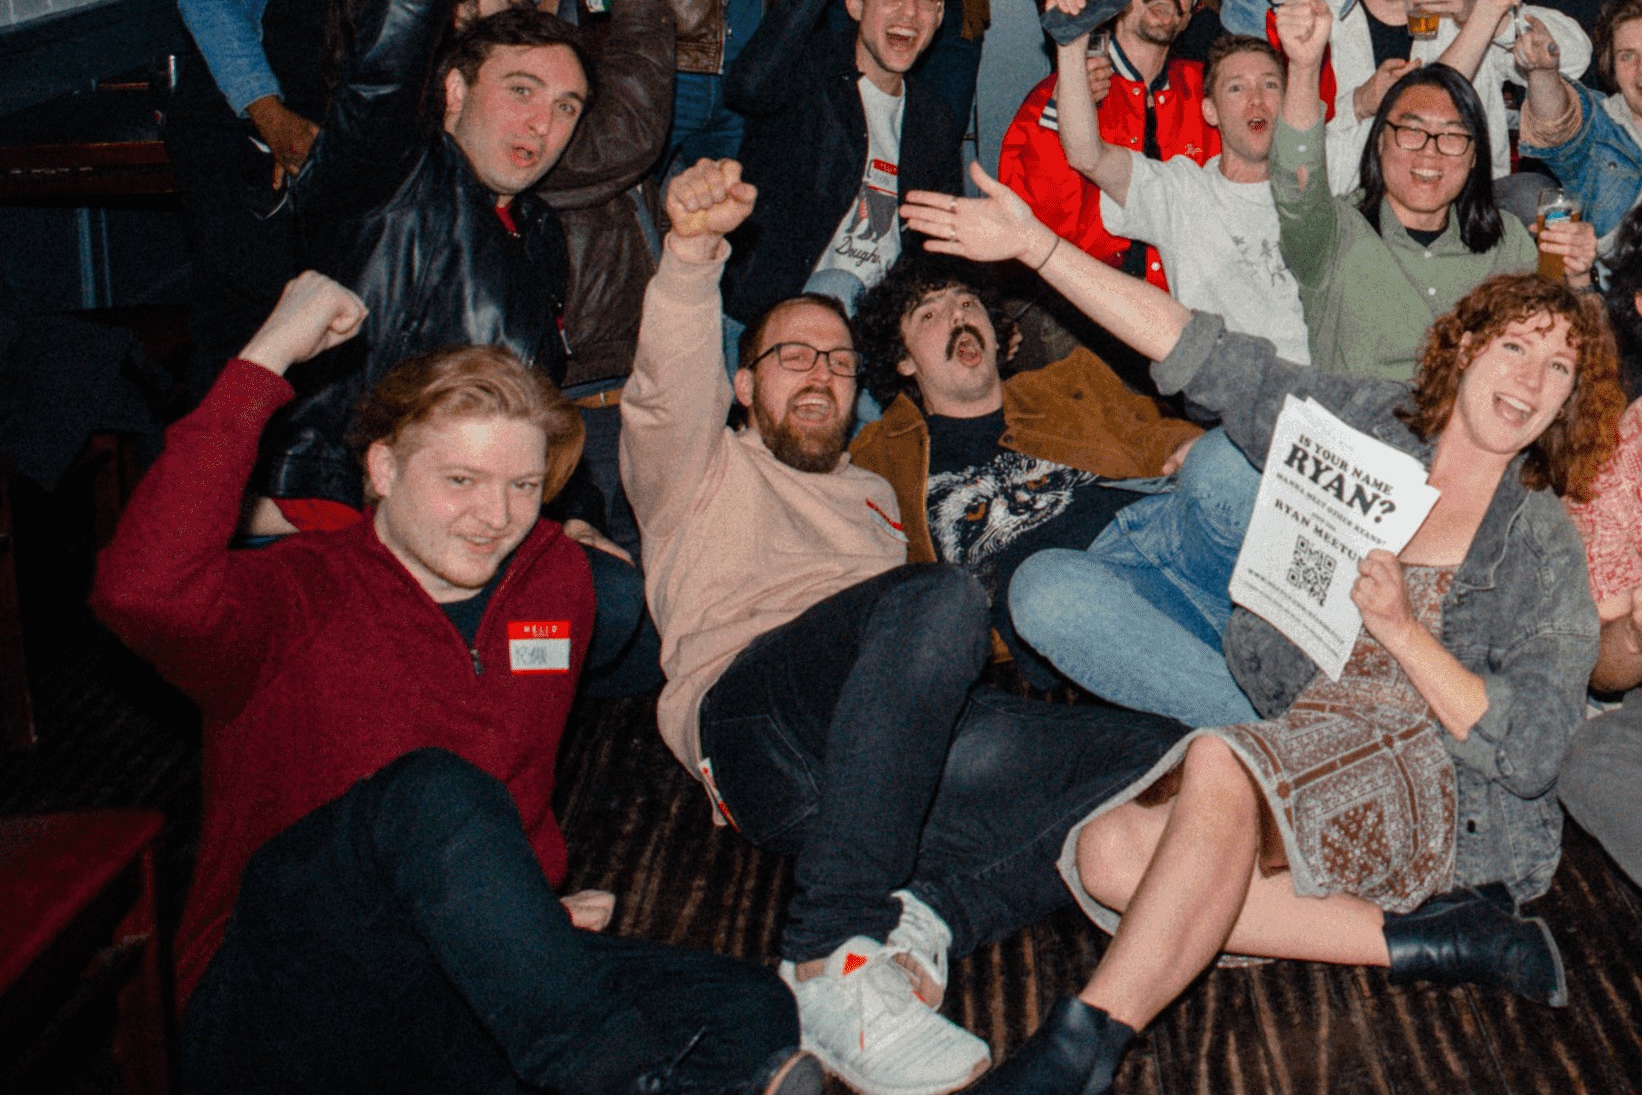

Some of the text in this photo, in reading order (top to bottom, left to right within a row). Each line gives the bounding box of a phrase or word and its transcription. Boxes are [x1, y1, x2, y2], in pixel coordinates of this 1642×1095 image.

[1283, 442, 1396, 524] RYAN?
[1298, 434, 1394, 496] IS YOUR NAME
[1274, 498, 1361, 562] RYAN MEETU
